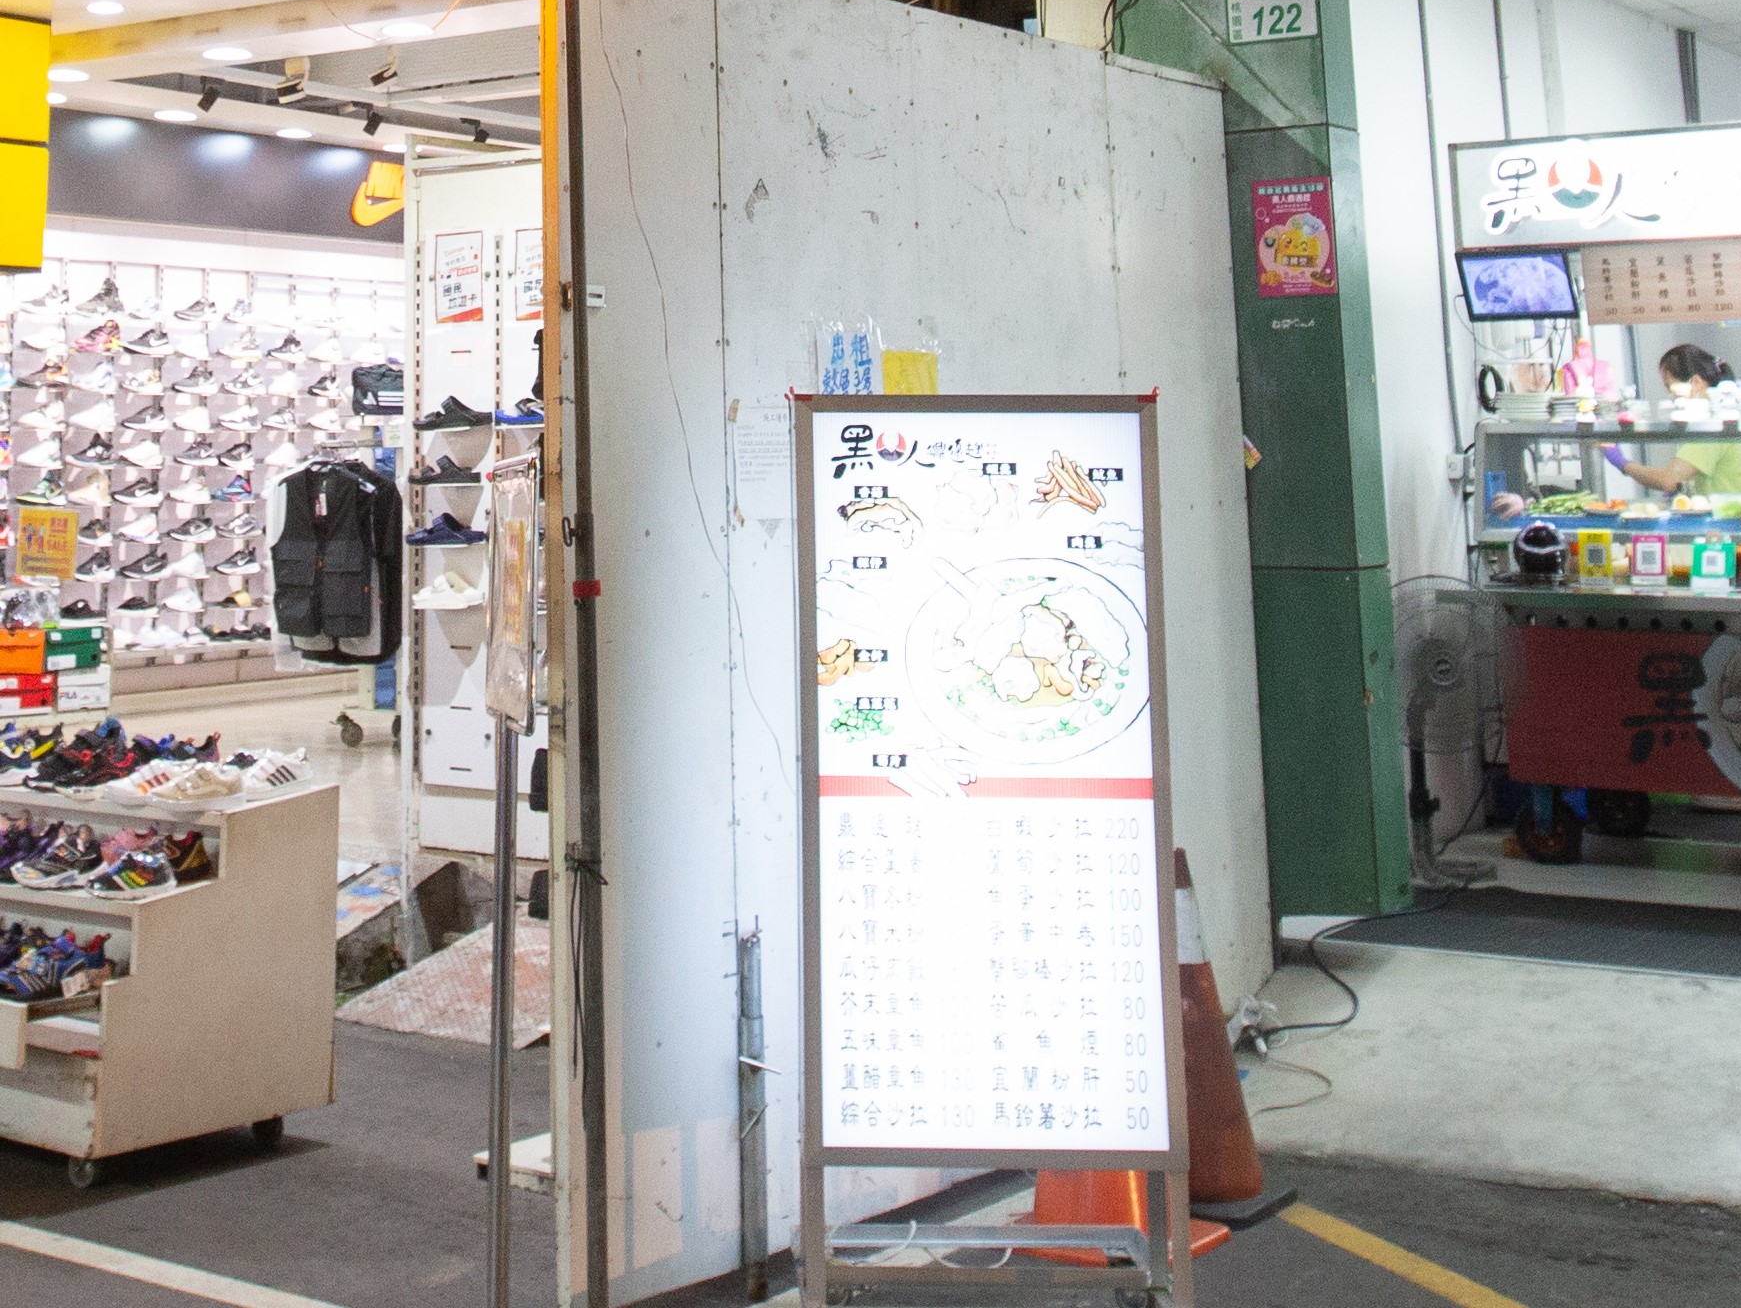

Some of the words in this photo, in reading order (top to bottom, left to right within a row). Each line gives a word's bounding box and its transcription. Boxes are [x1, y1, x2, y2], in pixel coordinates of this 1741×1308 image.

[1253, 3, 1302, 36] 122
[831, 425, 936, 479] 黑人
[59, 692, 77, 700] FILA
[1105, 817, 1139, 840] 220
[1108, 852, 1141, 876] 120
[1109, 888, 1142, 911] 100
[1110, 924, 1143, 947] 150
[1112, 960, 1144, 983] 120
[1124, 996, 1145, 1020] 80
[1125, 1033, 1146, 1056] 80
[1126, 1070, 1148, 1093] 50
[1127, 1106, 1149, 1129] 50
